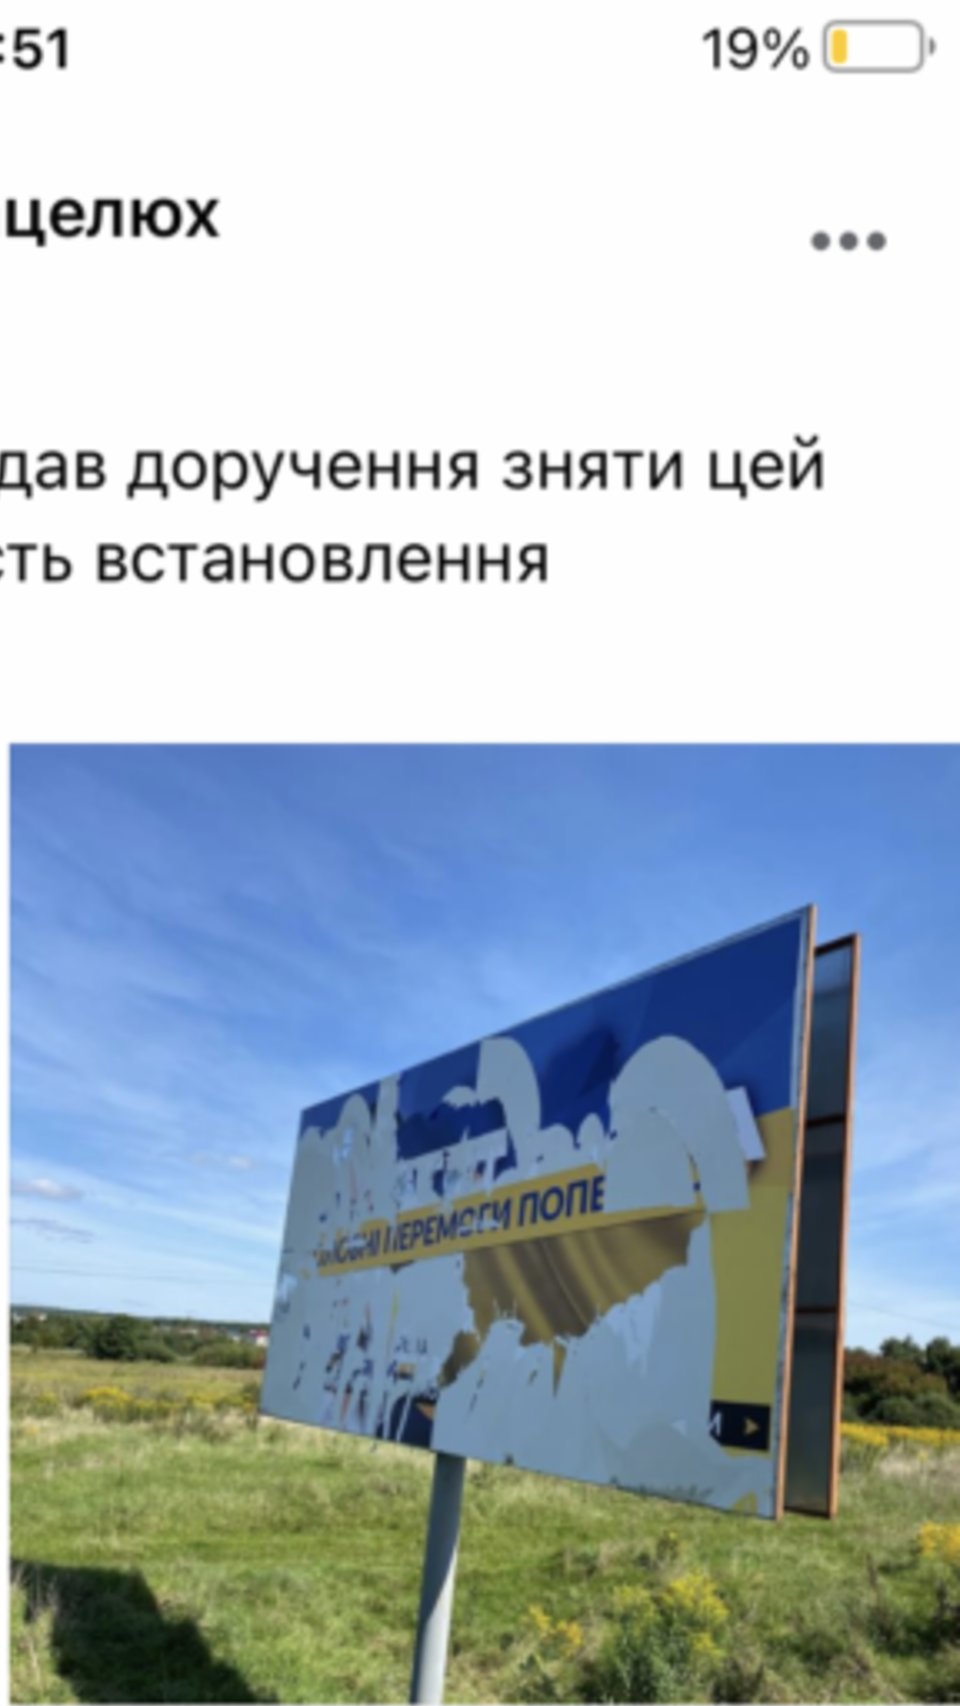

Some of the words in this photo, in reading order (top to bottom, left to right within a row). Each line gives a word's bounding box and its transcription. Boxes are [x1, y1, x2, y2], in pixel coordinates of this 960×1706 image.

[702, 26, 811, 71] 19%
[126, 449, 478, 503] доручення
[502, 449, 683, 491] зняти
[709, 433, 824, 500] цей
[96, 542, 548, 584] встановлення
